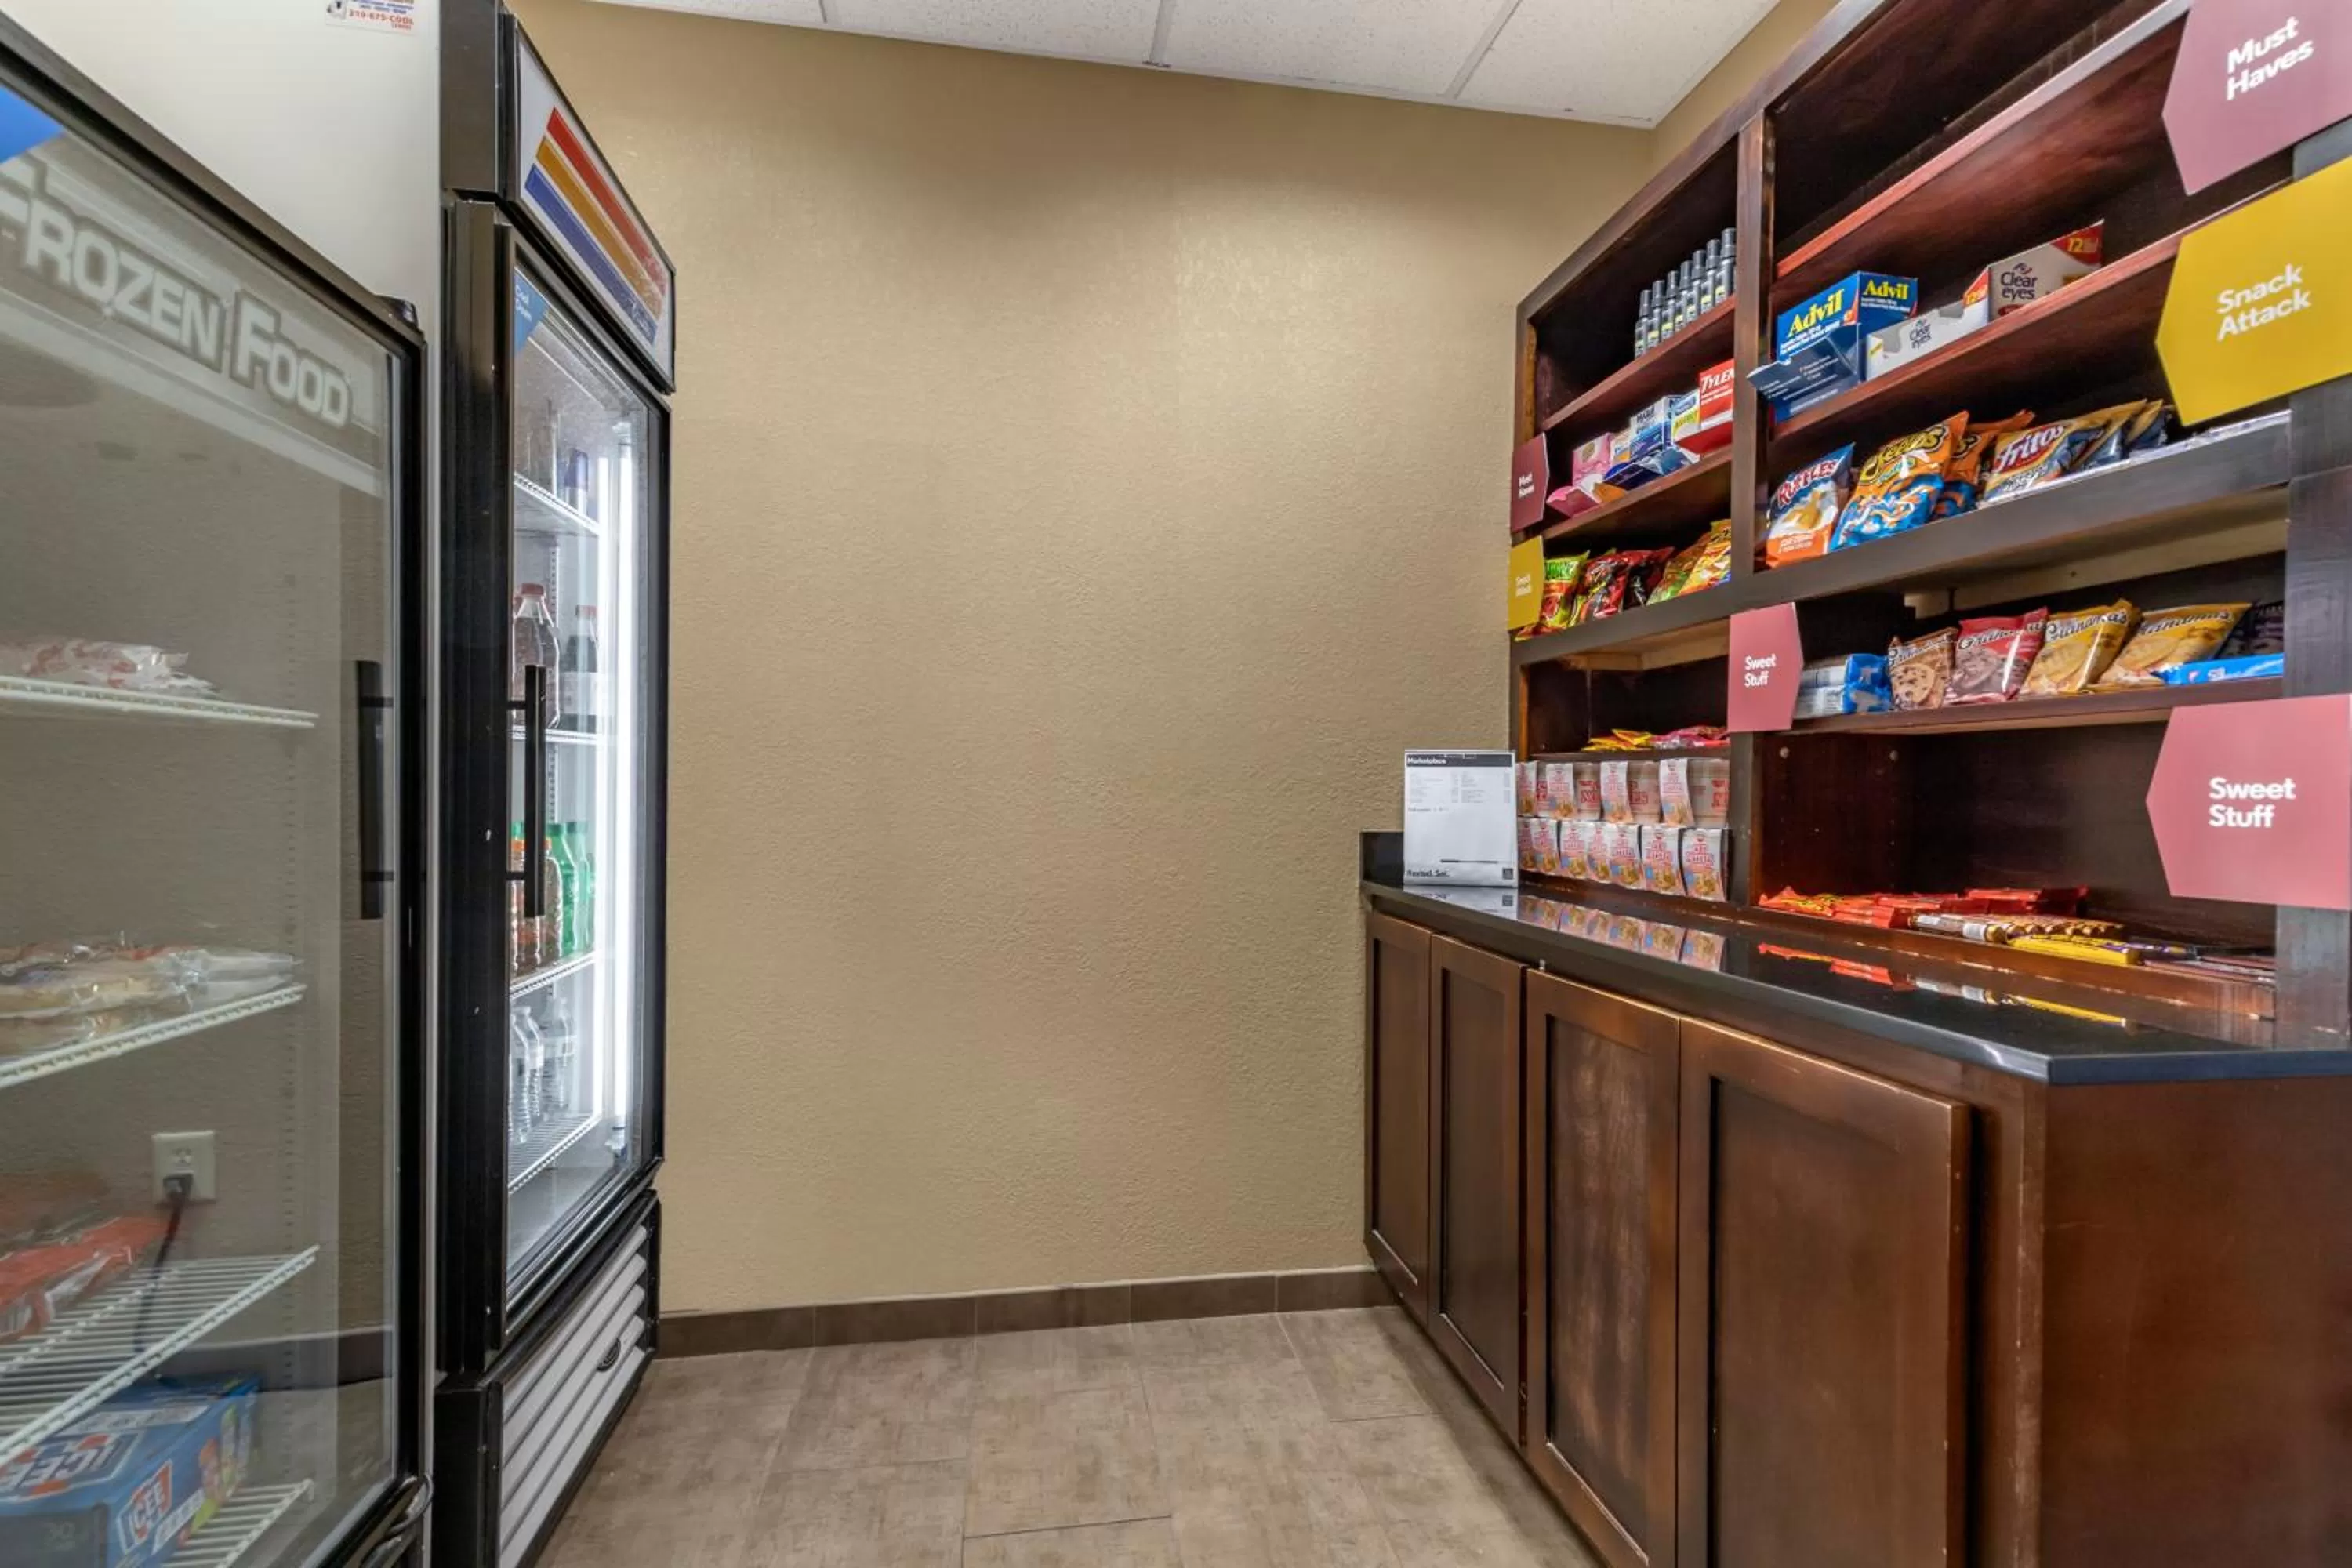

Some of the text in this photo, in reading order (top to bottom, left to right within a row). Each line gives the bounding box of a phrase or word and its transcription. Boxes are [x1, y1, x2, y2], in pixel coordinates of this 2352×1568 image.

[2227, 16, 2299, 74] Must
[2226, 40, 2314, 101] Haves
[1864, 279, 1910, 300] Advil
[2000, 272, 2038, 289] Clear
[2216, 263, 2303, 314] Snack
[2002, 287, 2035, 302] eyes
[1786, 288, 1846, 339] Advil
[2216, 288, 2312, 342] Attack
[1909, 322, 1932, 342] Clear
[236, 297, 350, 429] FOOD
[1996, 423, 2065, 472] Fritos
[1744, 653, 1777, 670] Sweet
[1744, 670, 1769, 688] Stuff
[2209, 777, 2296, 800] Sweet
[2208, 804, 2275, 828] Stuff
